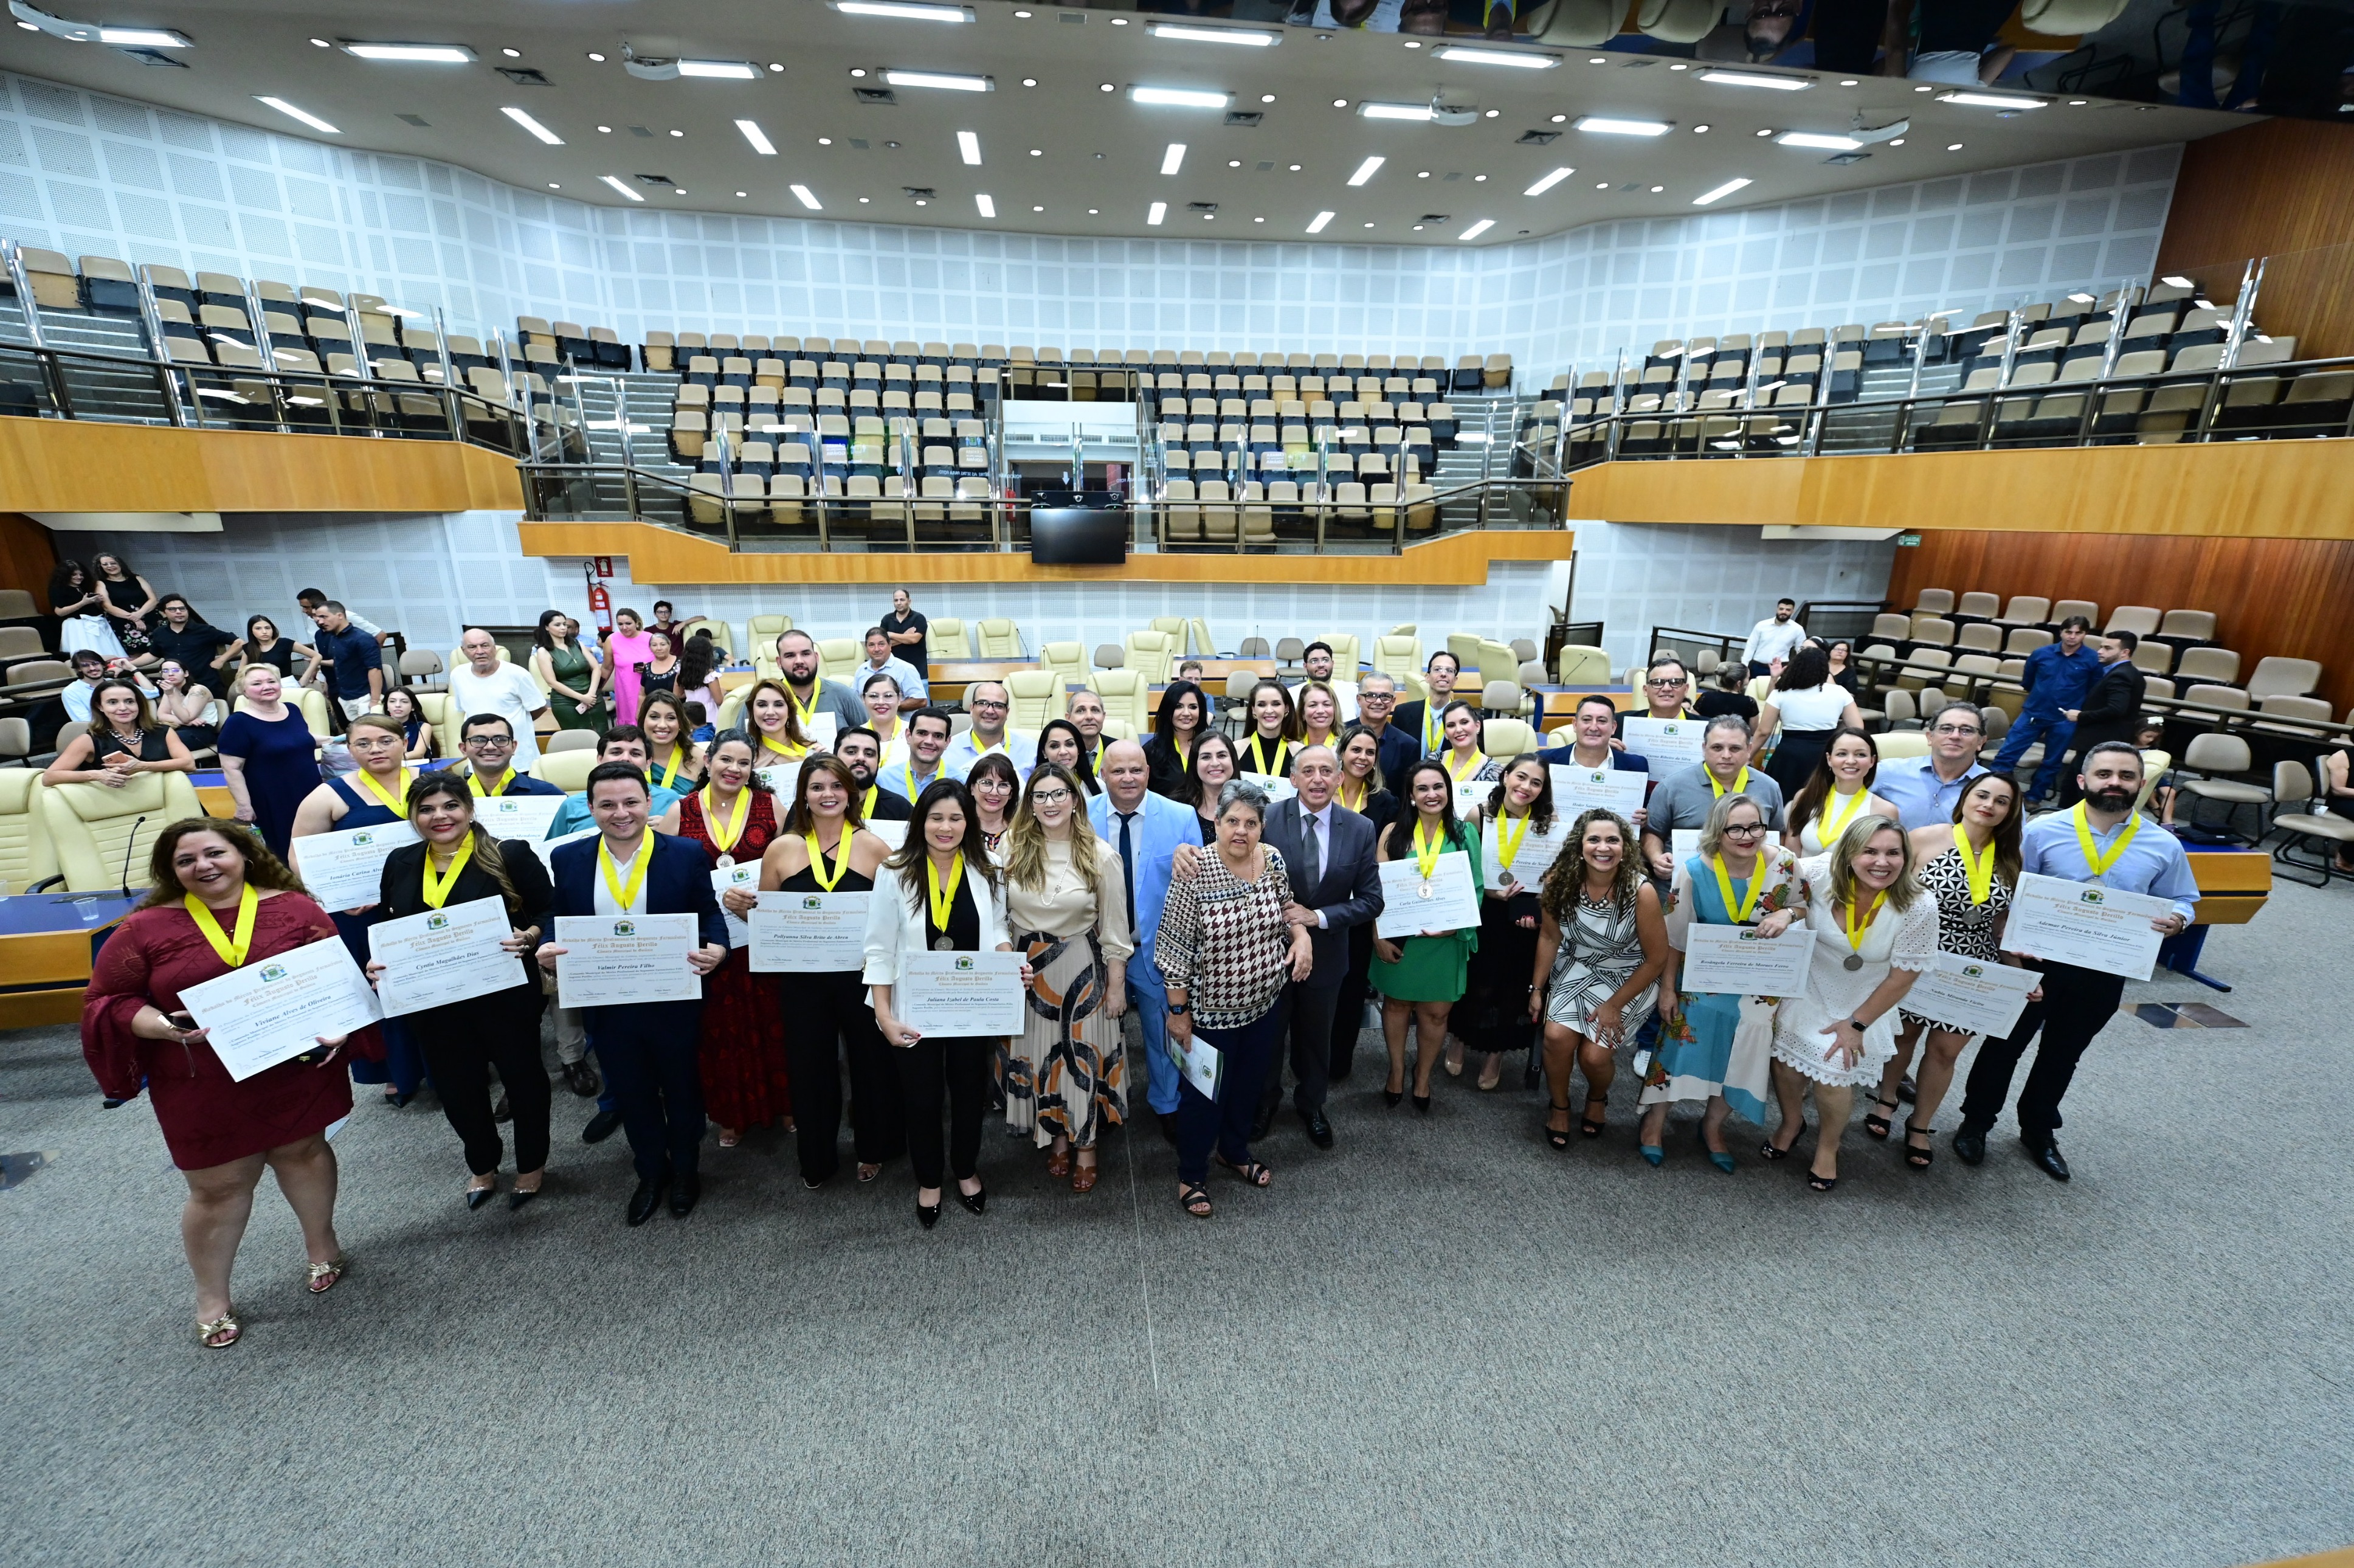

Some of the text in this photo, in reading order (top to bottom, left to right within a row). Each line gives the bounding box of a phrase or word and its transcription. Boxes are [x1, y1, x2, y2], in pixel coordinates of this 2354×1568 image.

[2073, 906, 2099, 915] Augusto
[427, 934, 452, 944] Augusto
[453, 929, 474, 938] Perillo
[436, 955, 465, 964] Magalhães
[264, 984, 294, 996] Augusto
[294, 975, 317, 986] Perillo
[1947, 993, 1968, 1002] Miranda
[255, 1015, 280, 1027] Viviane
[308, 995, 331, 1006] Oliveira
